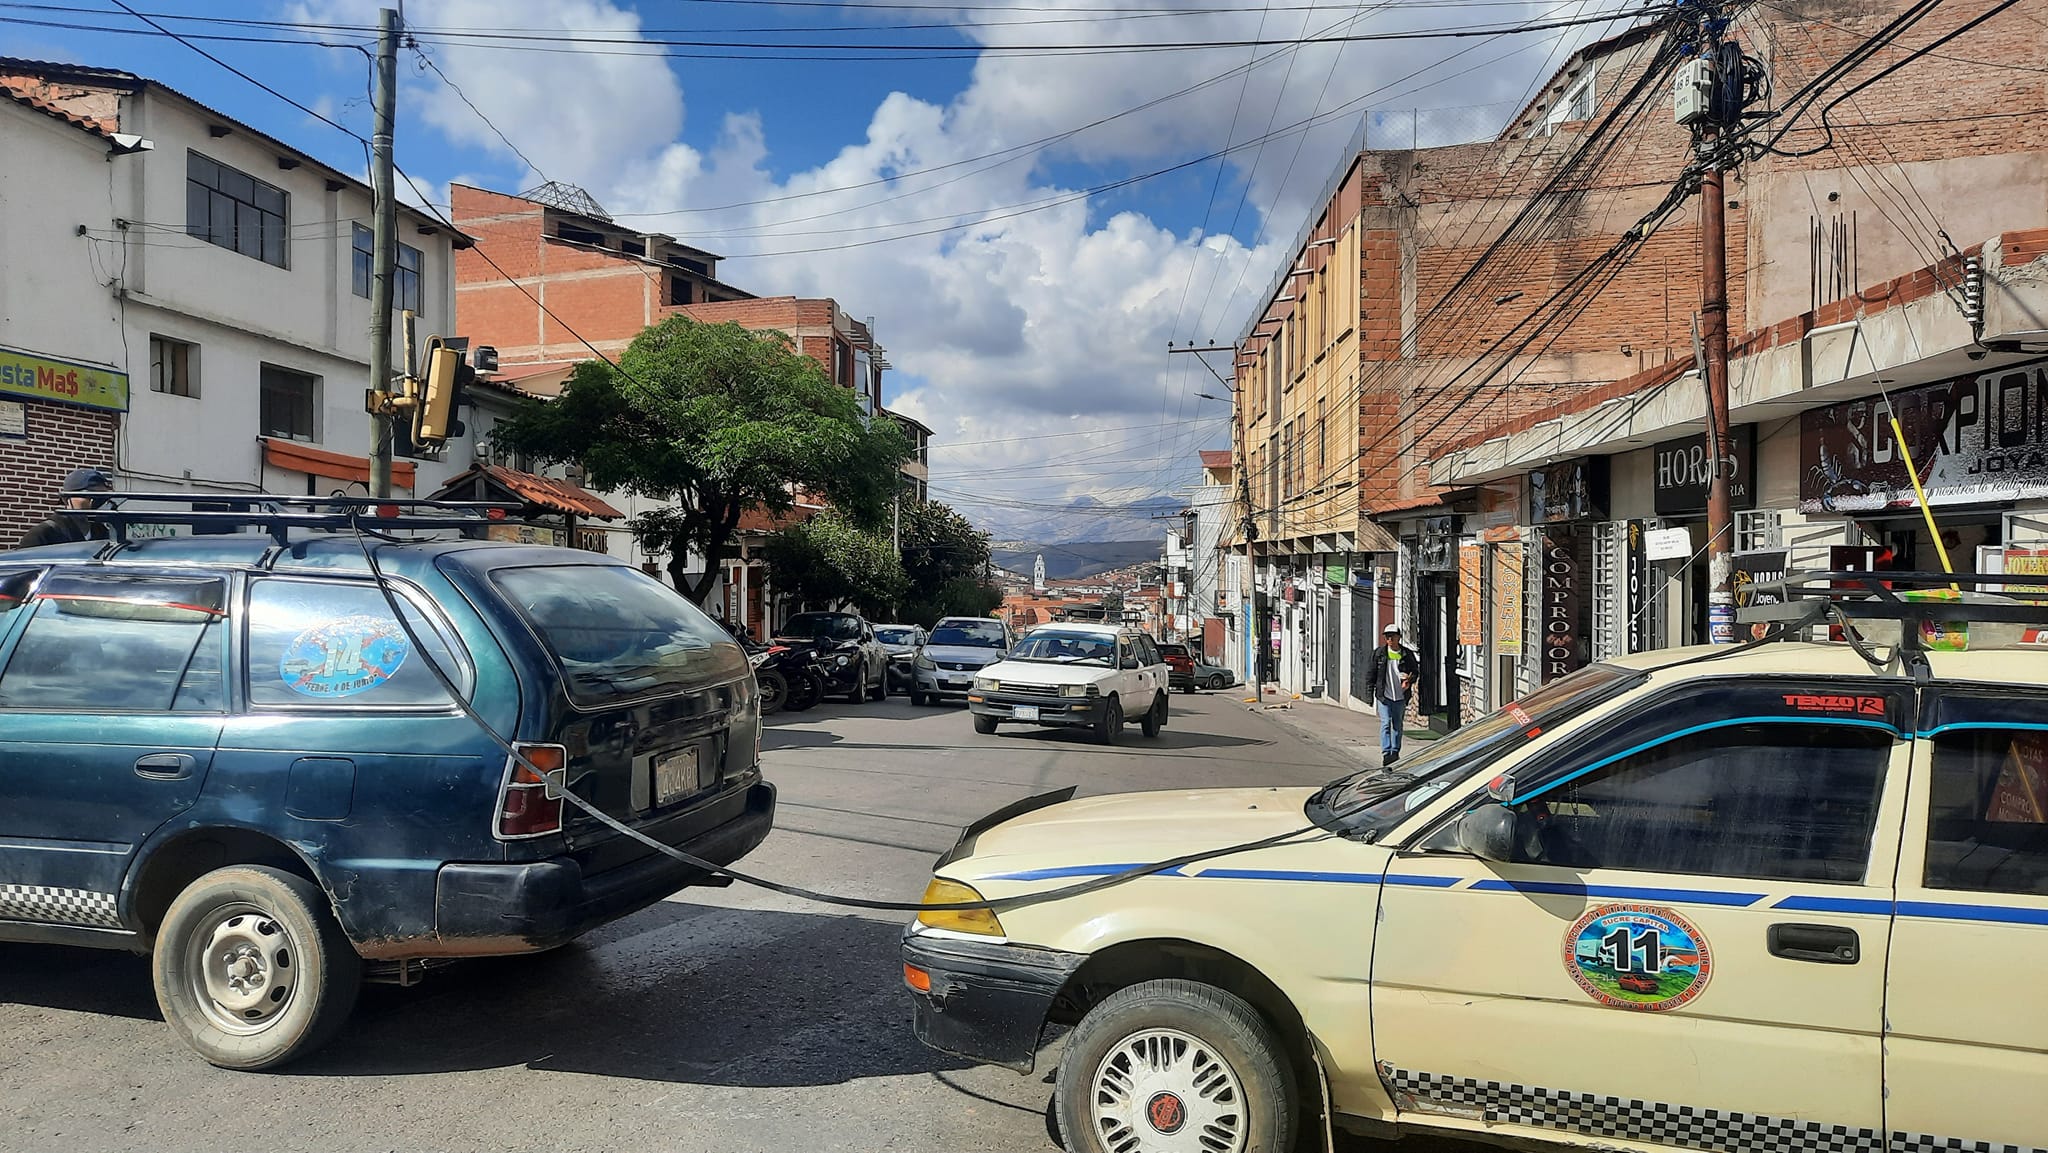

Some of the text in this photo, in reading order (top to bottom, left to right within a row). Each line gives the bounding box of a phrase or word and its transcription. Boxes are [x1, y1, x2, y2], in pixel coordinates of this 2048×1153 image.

[1547, 547, 1572, 633] COMPRO
[323, 636, 363, 678] 14
[1548, 647, 1571, 681] OR
[1782, 695, 1855, 708] TENZO
[1602, 916, 1669, 933] SUCRE CAPITAL
[1603, 927, 1660, 973] 11
